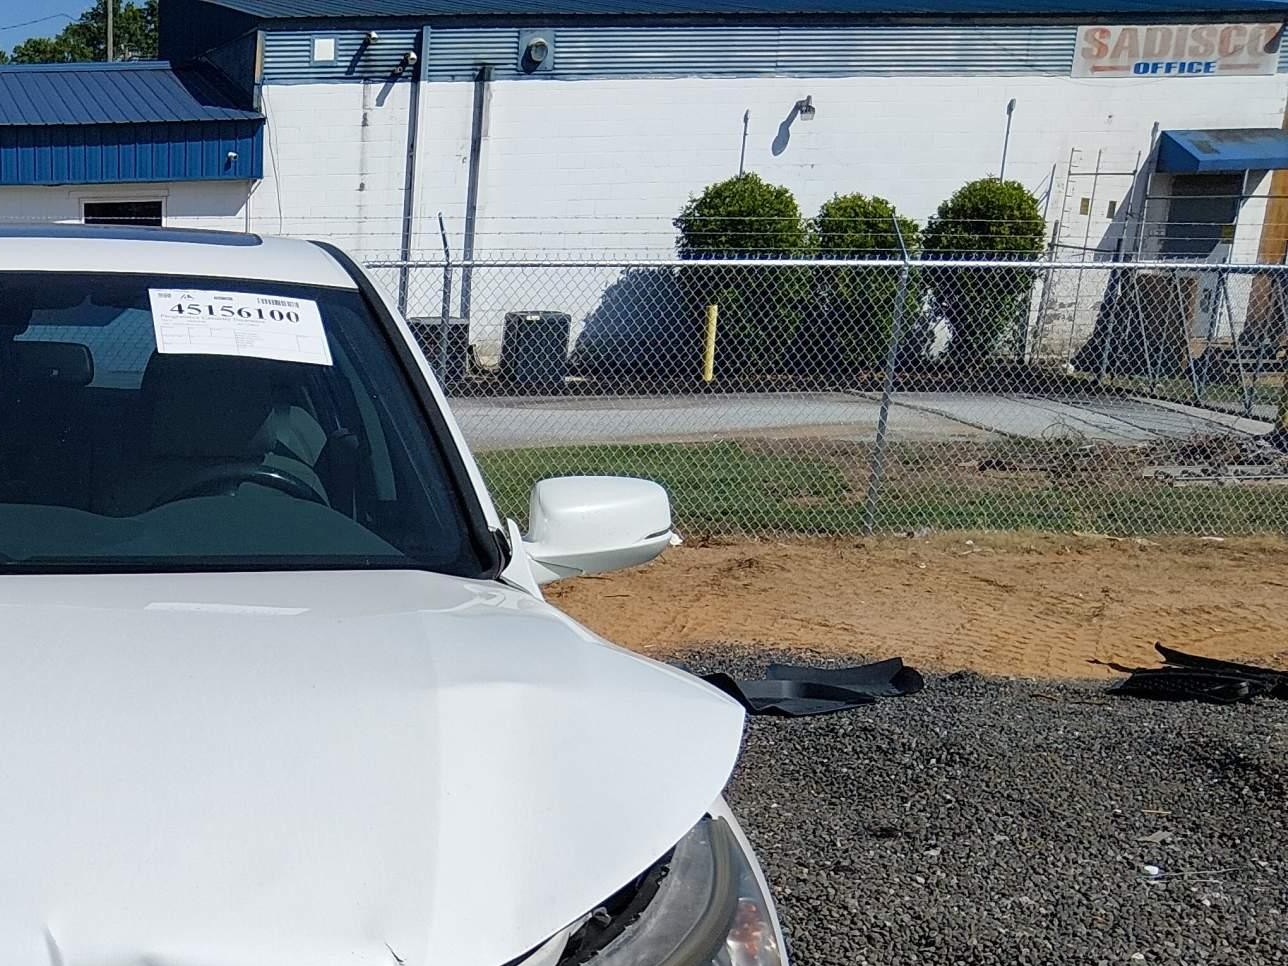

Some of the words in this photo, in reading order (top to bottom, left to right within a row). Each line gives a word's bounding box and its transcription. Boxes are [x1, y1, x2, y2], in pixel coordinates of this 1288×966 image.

[1081, 25, 1279, 60] SADISCO
[1133, 61, 1217, 75] OFFICE
[170, 303, 300, 323] 45156100
